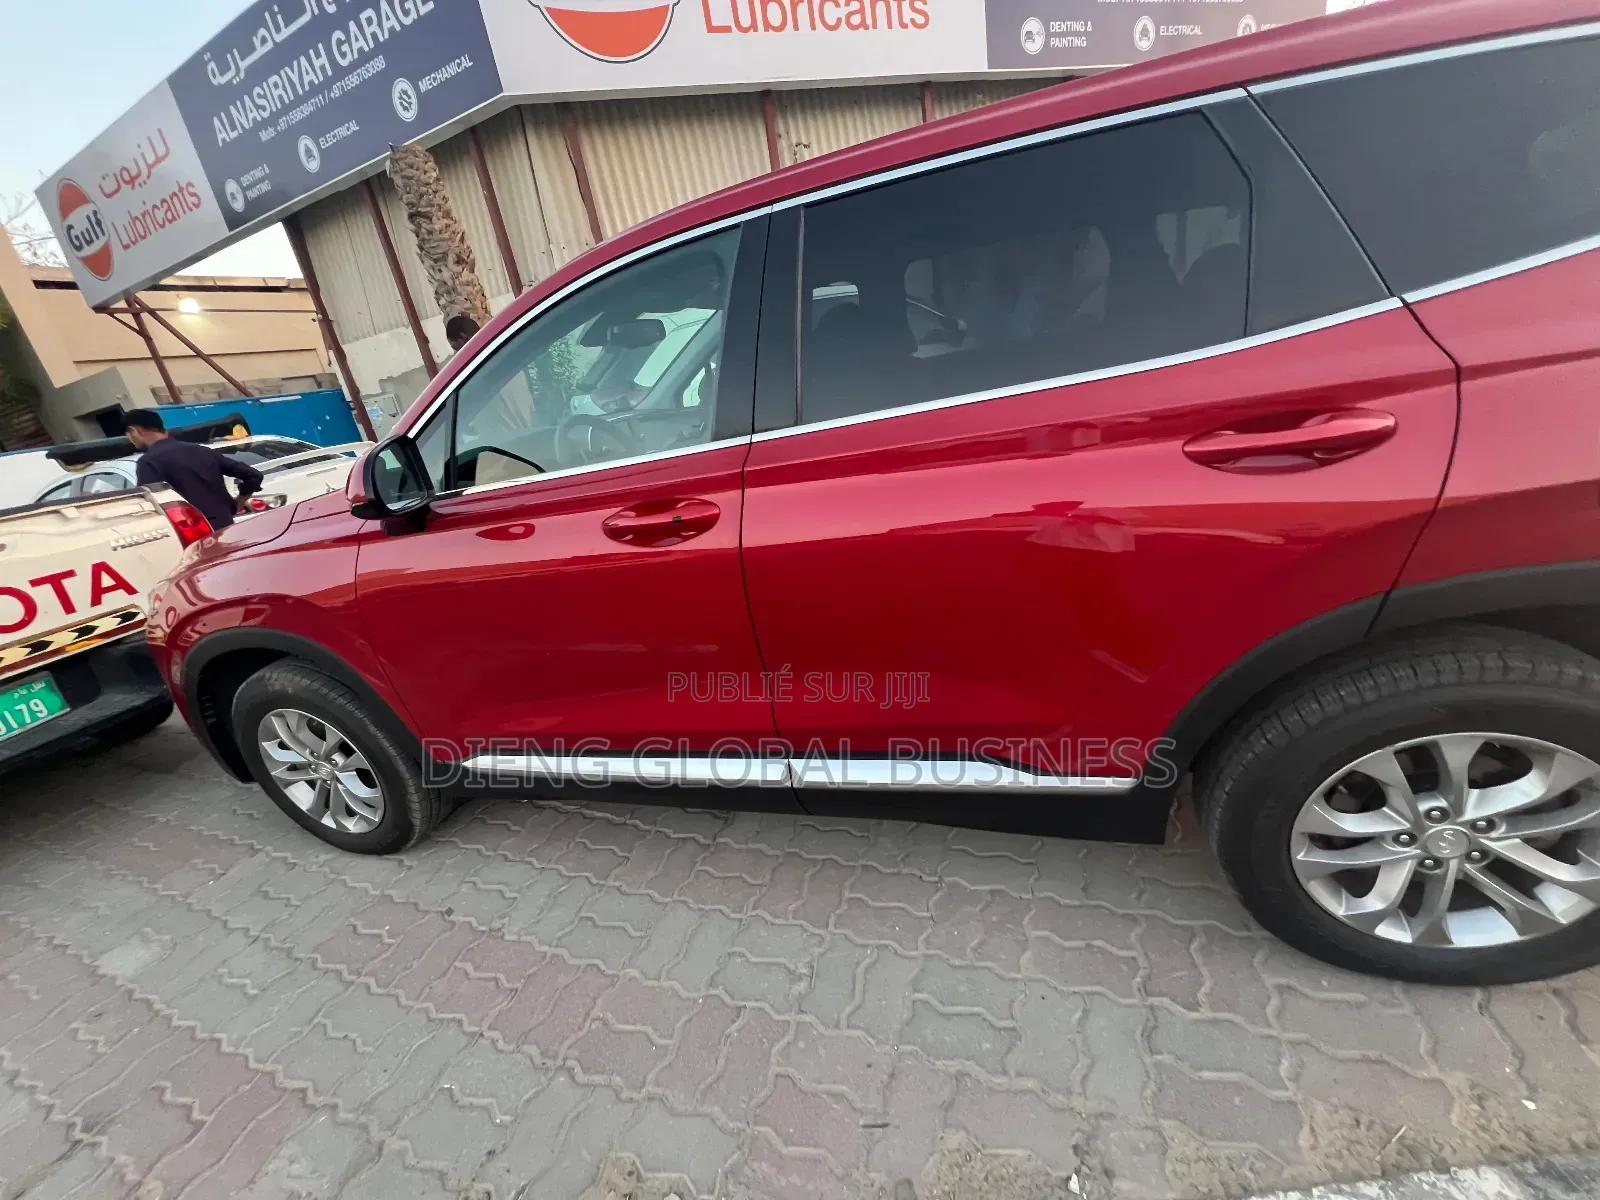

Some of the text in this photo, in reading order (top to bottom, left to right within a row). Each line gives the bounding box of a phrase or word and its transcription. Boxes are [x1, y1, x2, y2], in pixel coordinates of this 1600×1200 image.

[702, 0, 930, 34] Lubricants
[1050, 20, 1093, 33] DENTING &
[1159, 25, 1203, 36] ELECTRICAL
[1050, 36, 1087, 48] PAINTING
[418, 54, 474, 94] MECHANICAL
[212, 43, 332, 147] ALNASIRIYAH
[319, 120, 360, 149] ELECTRICAL
[98, 127, 170, 199] للزيوت
[66, 209, 106, 252] Gulf
[111, 180, 202, 251] Lubricants
